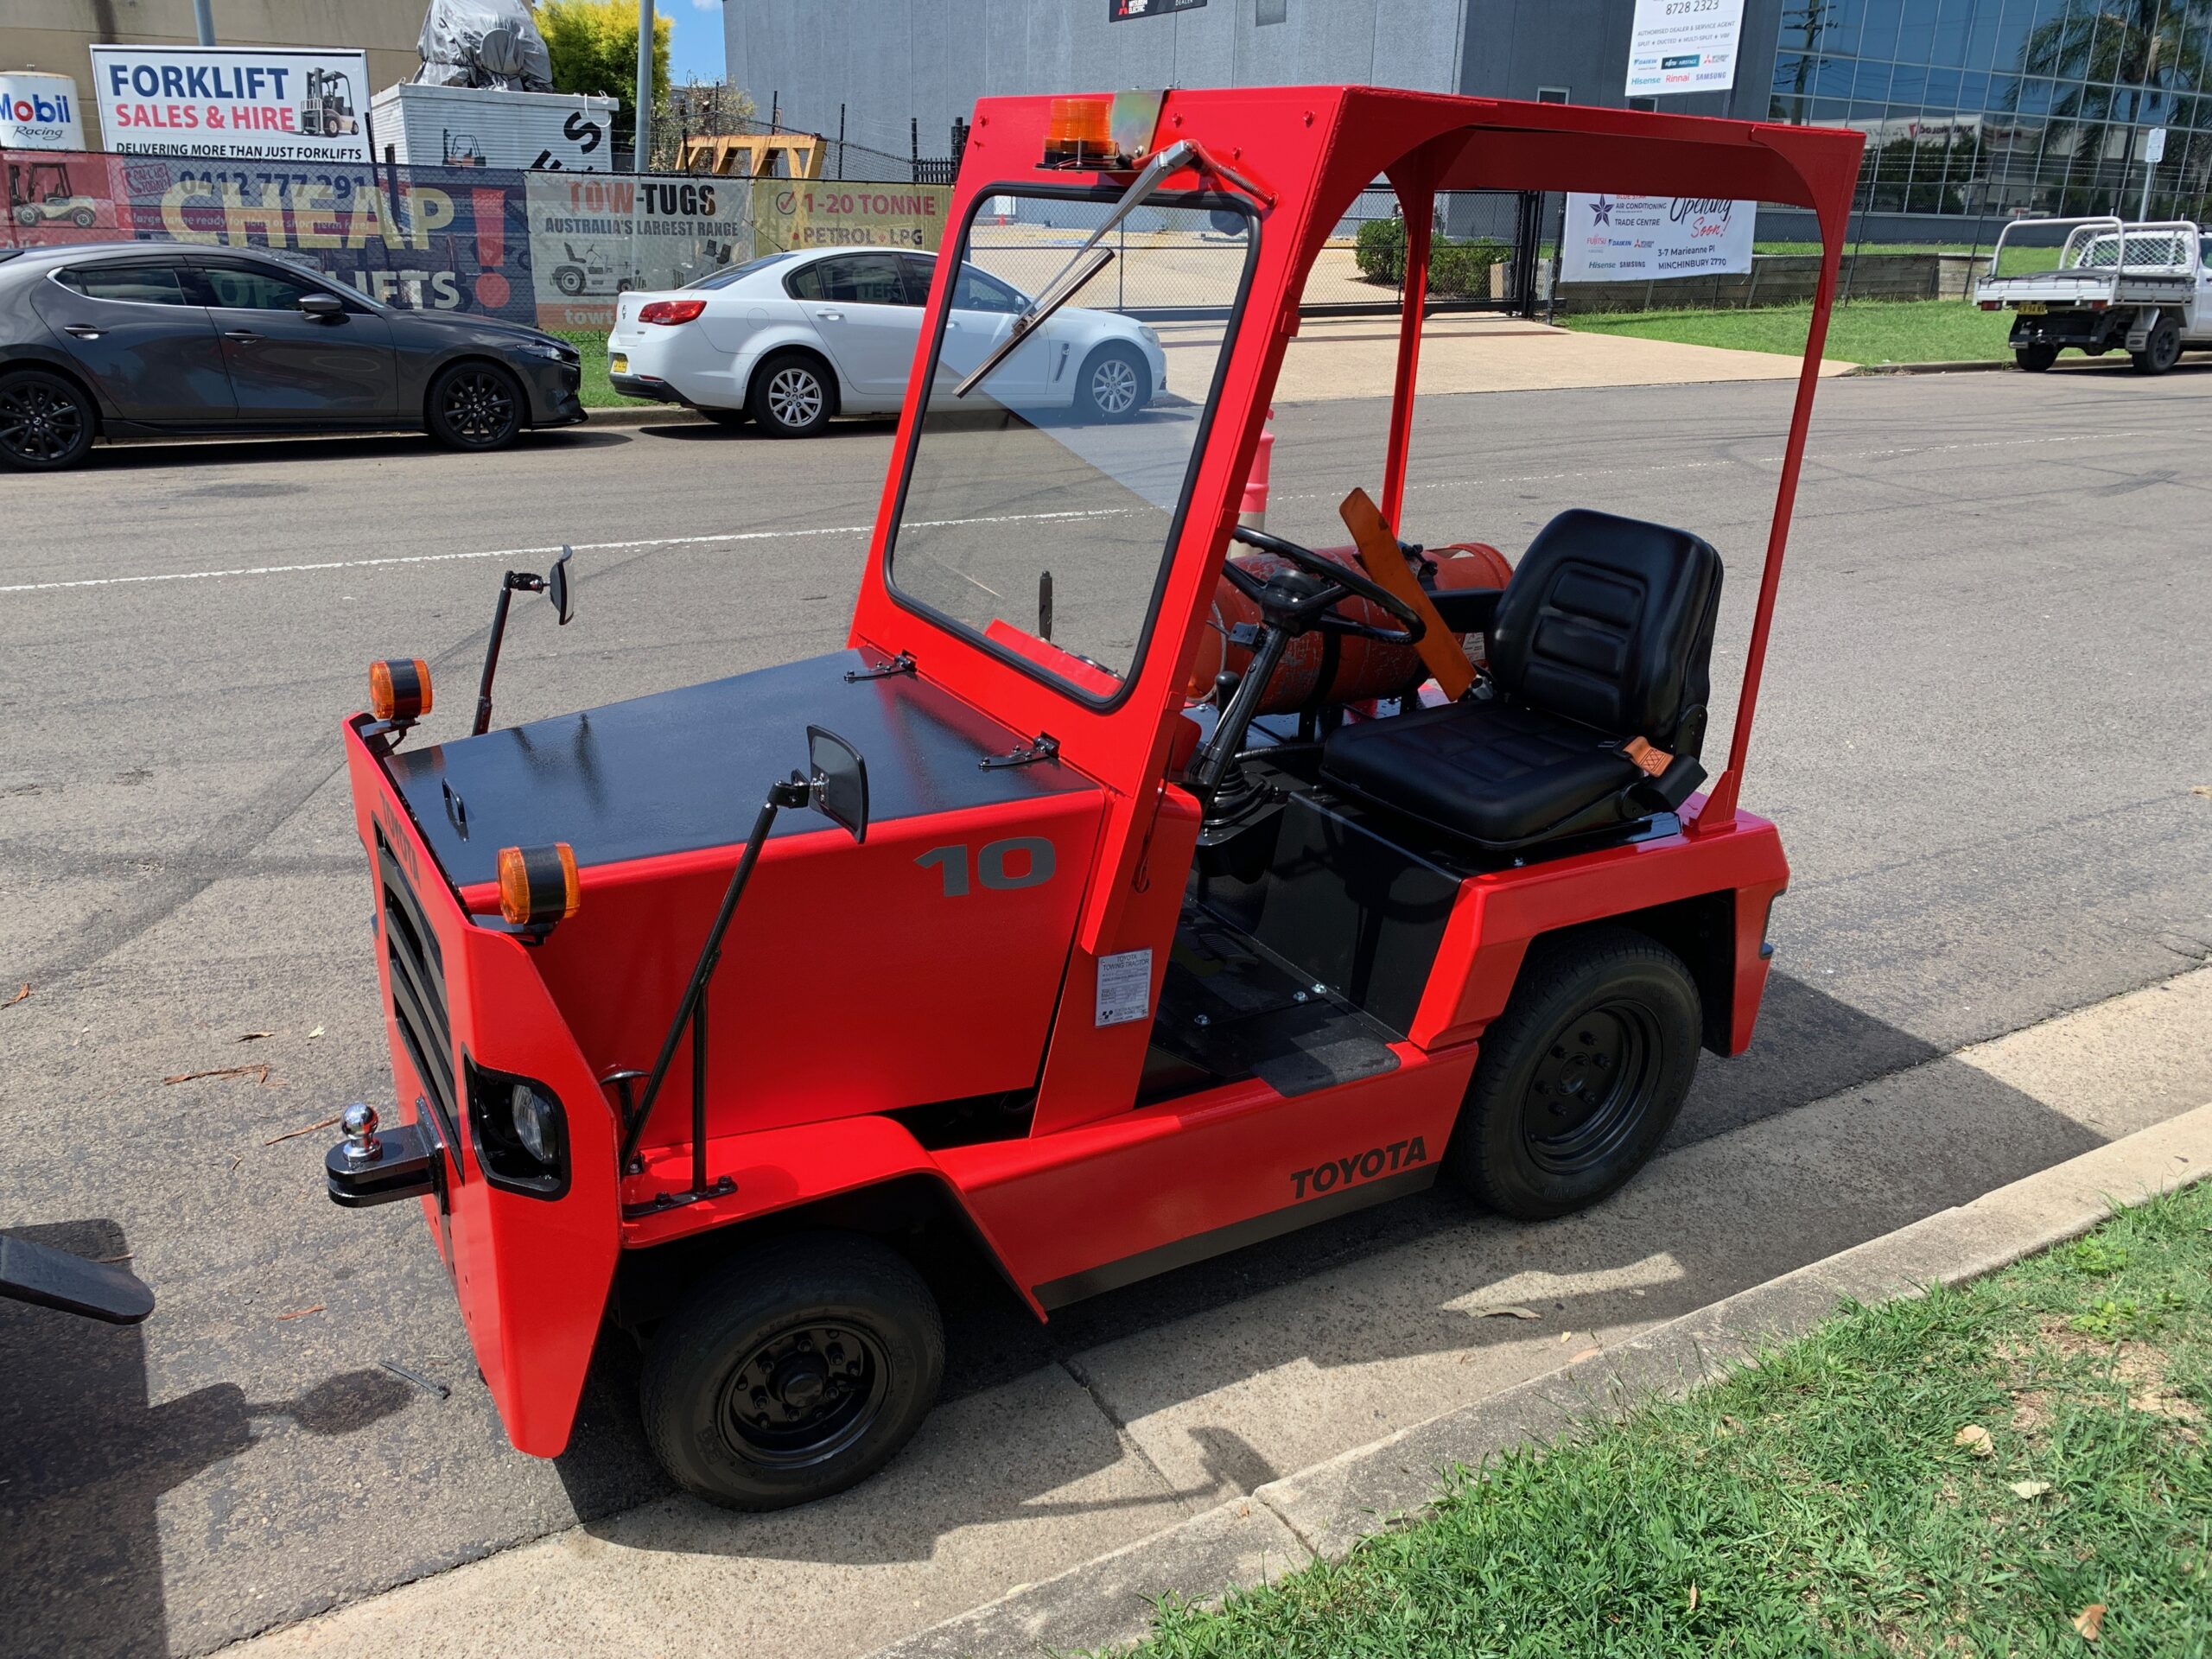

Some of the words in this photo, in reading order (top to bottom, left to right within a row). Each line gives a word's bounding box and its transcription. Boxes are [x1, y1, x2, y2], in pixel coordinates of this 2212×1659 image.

[1666, 3, 1691, 16] 8728
[1694, 0, 1719, 12] 2323
[109, 64, 289, 100] FORKLIFT
[1631, 77, 1662, 86] Hisense
[1665, 73, 1690, 83] Rinnai
[1695, 72, 1726, 81] SAMSUNG
[0, 92, 71, 124] Mobil
[115, 104, 199, 128] SALES
[206, 105, 226, 129] &
[232, 105, 296, 131] HIRE
[12, 125, 65, 141] Racing
[117, 143, 188, 156] DELIVERING
[191, 144, 226, 156] MORE
[229, 145, 263, 157] THAN
[265, 146, 294, 158] JUST
[296, 147, 362, 160] FORKLIFTS
[256, 172, 308, 198] 777
[566, 181, 716, 216] TOW-TUGS
[804, 193, 854, 214] 1-20
[858, 194, 936, 215] TONNE
[161, 181, 454, 250] CHEAP
[196, 215, 226, 227] ready
[1637, 218, 1660, 226] CENTRE
[545, 217, 633, 235] AUSTRALIA'S
[636, 220, 694, 236] LARGEST
[697, 221, 739, 237] RANGE
[804, 226, 875, 245] PETROL
[889, 228, 923, 245] LPG
[1690, 215, 1732, 238] Soon!
[1657, 248, 1669, 257] 3-7
[1670, 246, 1707, 257] Marieanne
[1658, 258, 1709, 270] MINCHINBURY
[1710, 257, 1726, 266] 2770
[913, 836, 1056, 898] 10
[1103, 963, 1124, 971] TOWING
[1125, 959, 1149, 968] TRACTOR
[1116, 954, 1137, 963] TOYOTA
[1290, 1135, 1427, 1199] TOYOTA
